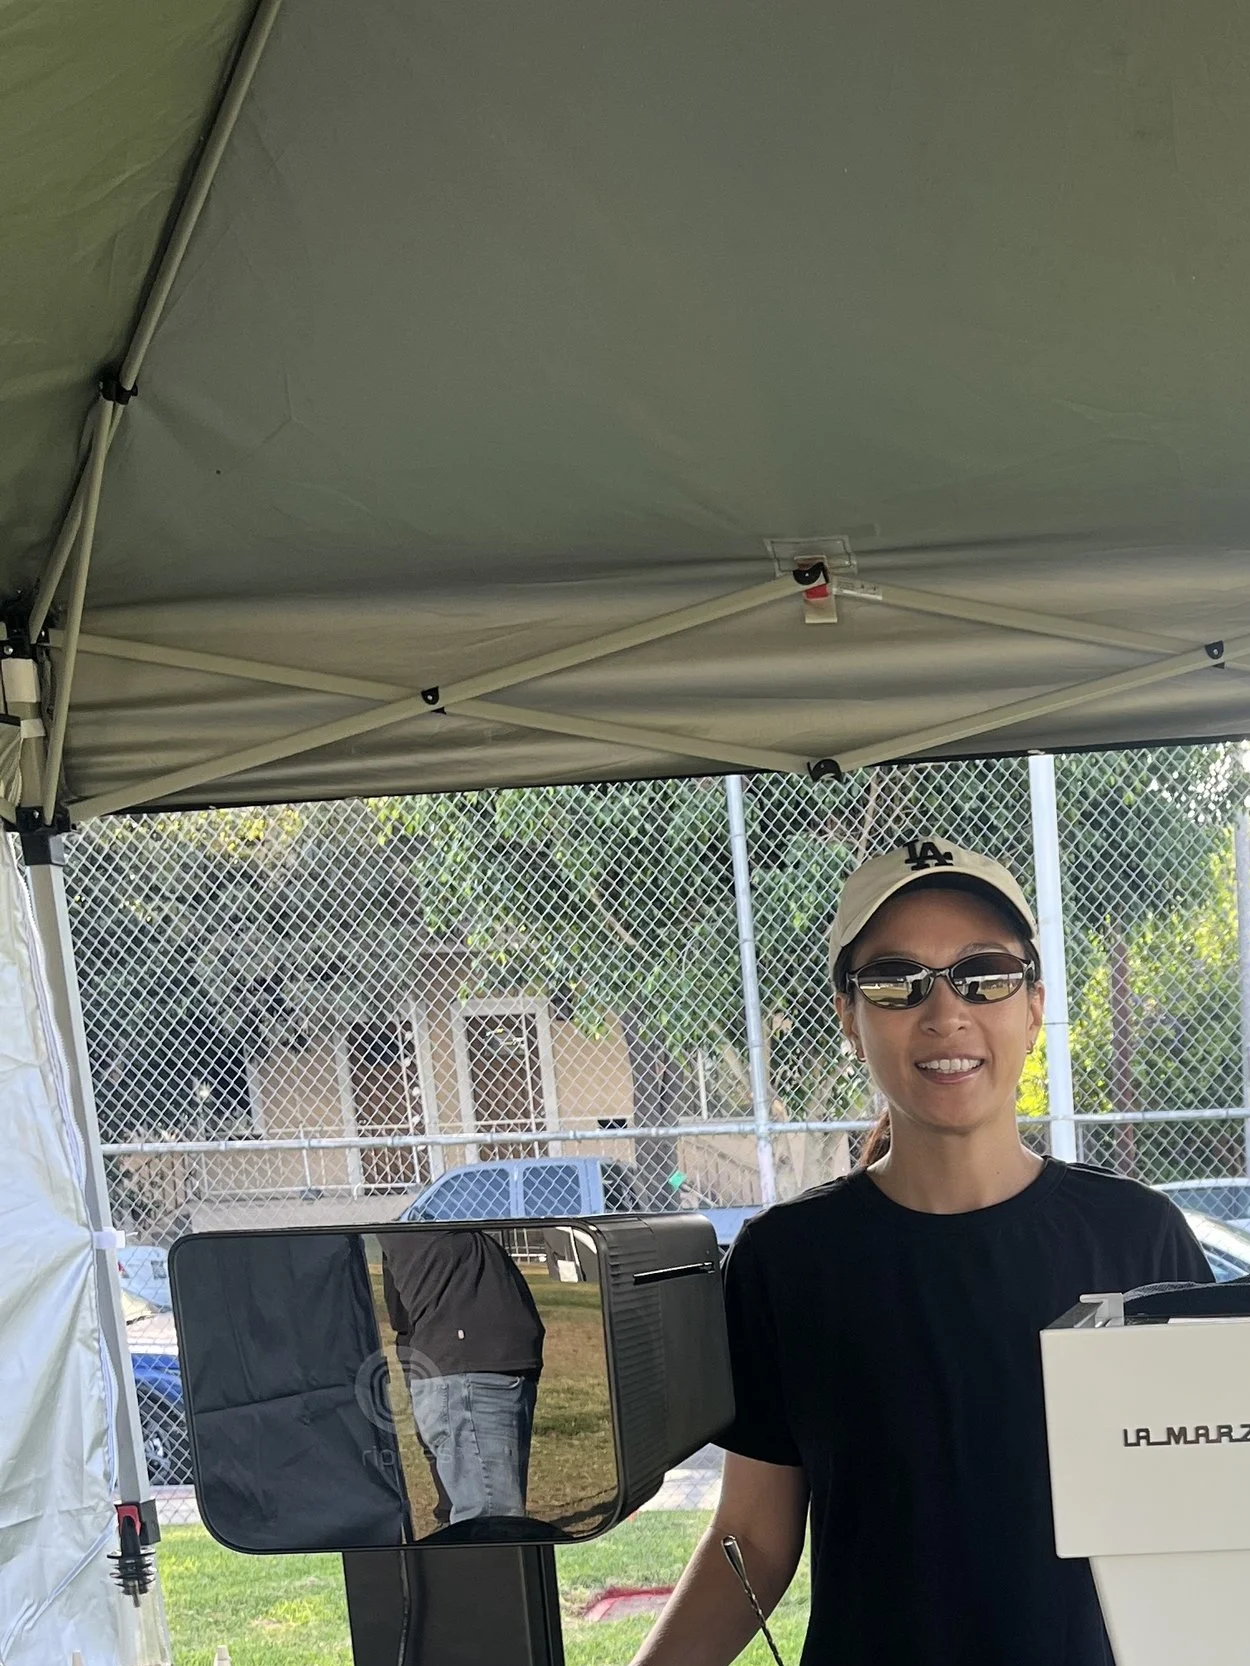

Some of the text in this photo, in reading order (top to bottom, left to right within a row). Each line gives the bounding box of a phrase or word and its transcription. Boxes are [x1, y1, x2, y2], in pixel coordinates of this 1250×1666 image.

[902, 838, 954, 871] LA
[1123, 1428, 1151, 1447] LA
[362, 1446, 453, 1471] rippes
